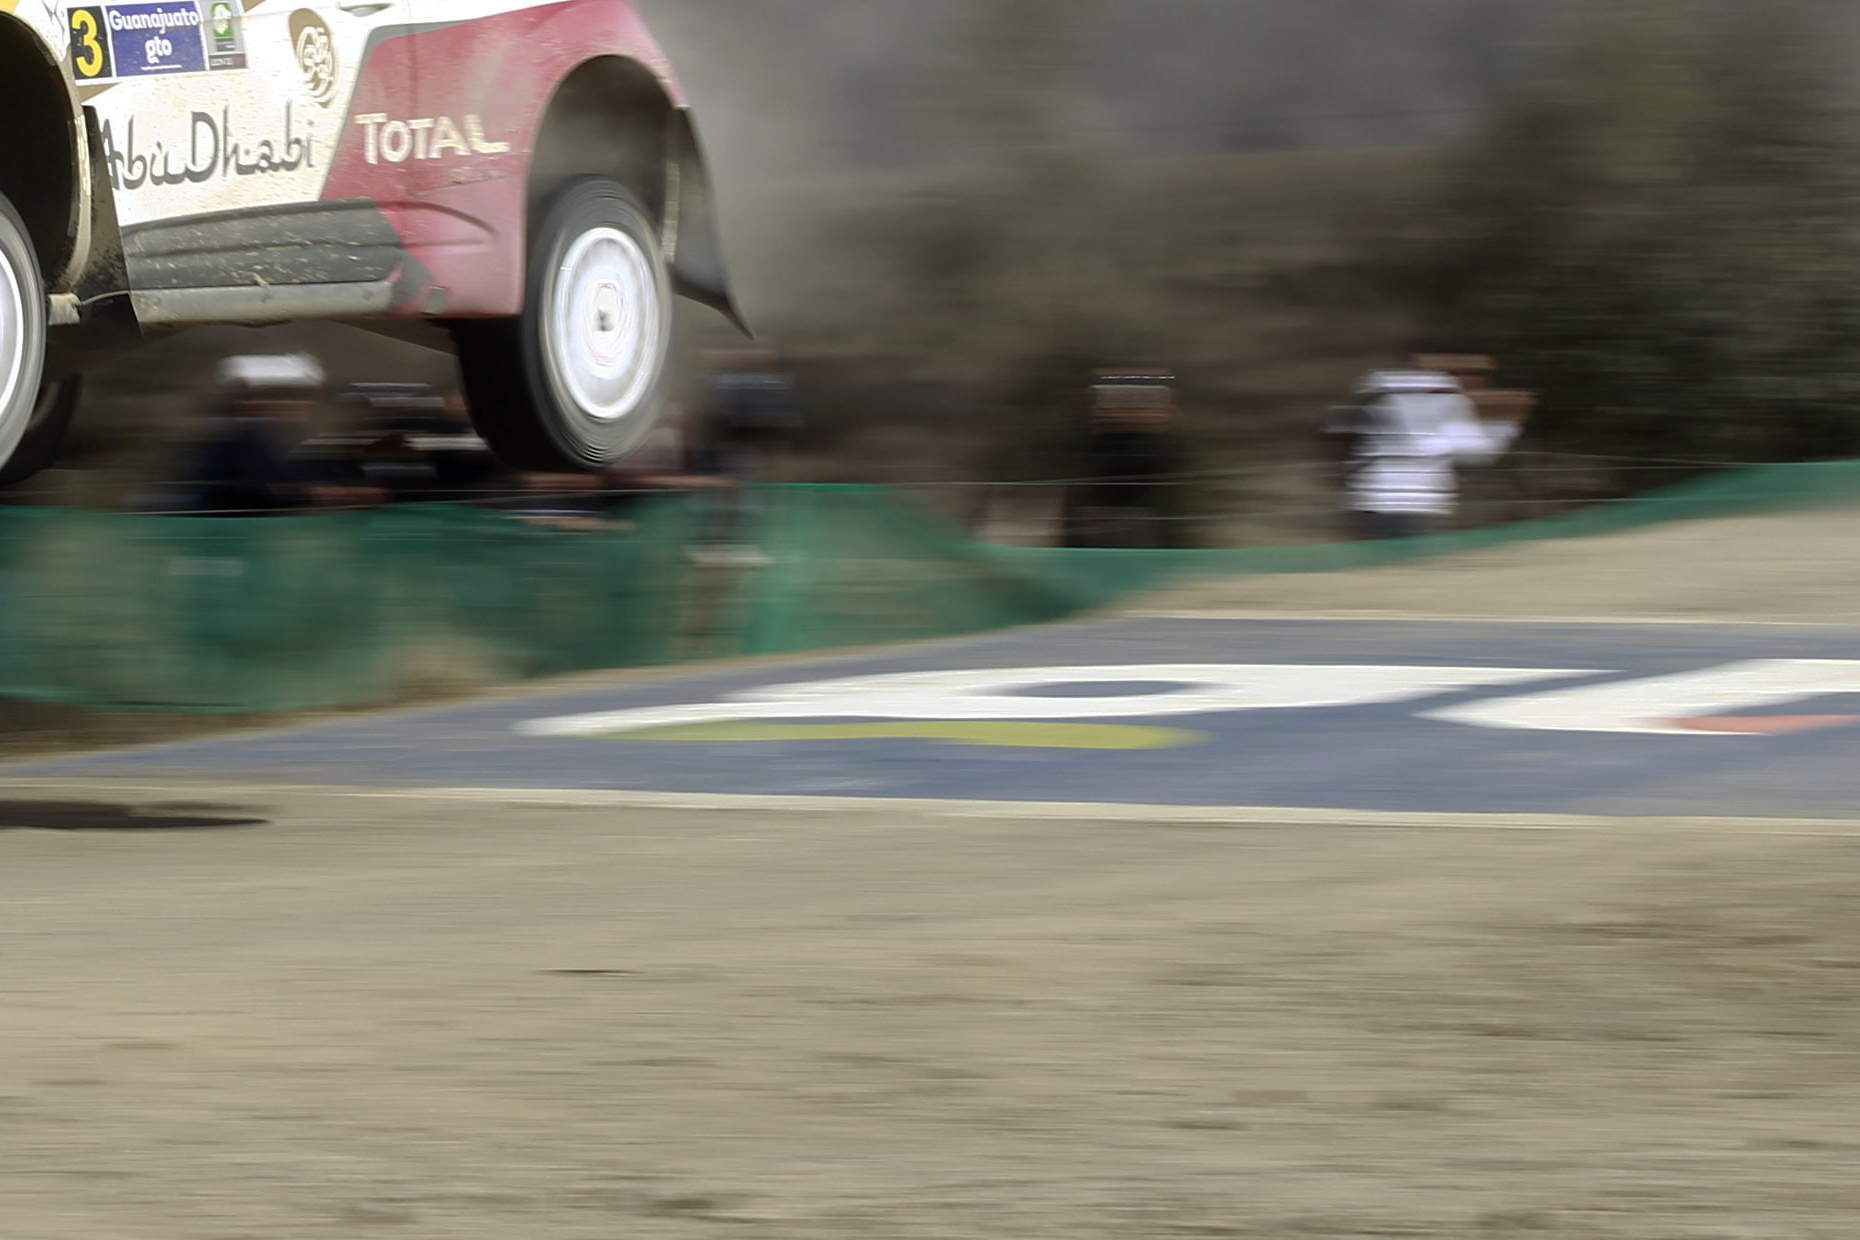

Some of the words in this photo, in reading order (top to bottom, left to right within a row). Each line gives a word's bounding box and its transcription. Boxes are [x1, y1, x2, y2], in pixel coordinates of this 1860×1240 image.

[109, 7, 200, 35] Guanajuato
[71, 9, 103, 77] 3
[145, 36, 173, 64] gto
[354, 113, 512, 165] TOTAL
